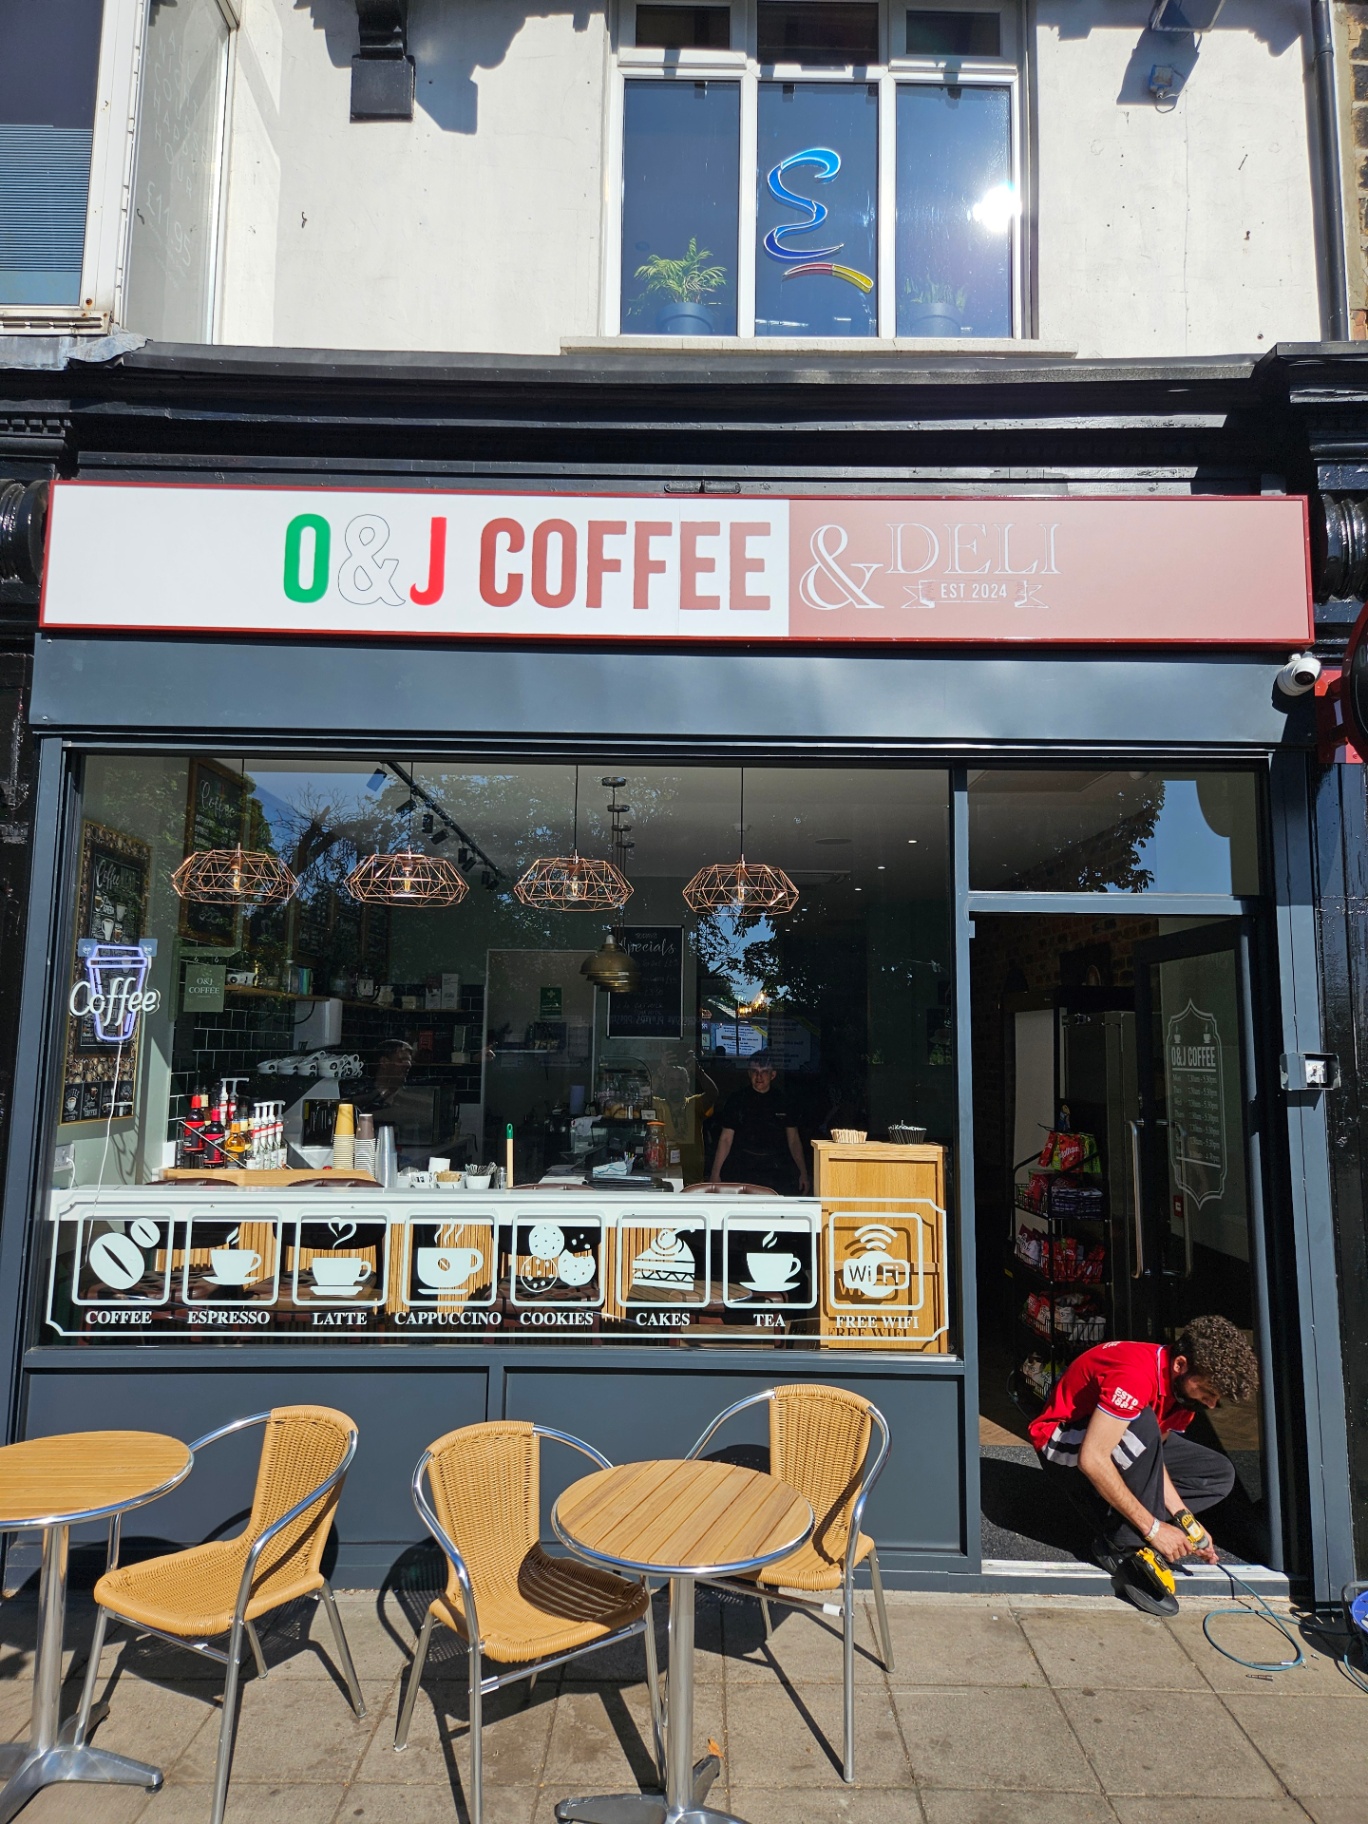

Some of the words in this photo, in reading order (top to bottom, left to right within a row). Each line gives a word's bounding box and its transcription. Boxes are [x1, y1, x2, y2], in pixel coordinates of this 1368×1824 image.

[479, 517, 771, 610] COFFEE
[799, 524, 884, 611] &
[885, 523, 1062, 574] DELI
[941, 584, 966, 598] EST
[972, 583, 1008, 598] 2024
[618, 936, 676, 957] Specials
[196, 977, 213, 986] O&J
[69, 977, 157, 1026] Coffee
[1171, 1046, 1187, 1067] O&J
[1187, 1046, 1216, 1067] COFFEE
[85, 1310, 152, 1324] COFFEE
[187, 1310, 270, 1324] ESPRESSO
[312, 1312, 368, 1326] LATTE
[394, 1311, 502, 1326] CAPPUCCINO
[519, 1311, 594, 1326] COOKIES
[635, 1312, 691, 1326] CAKES
[753, 1313, 786, 1327] TEA
[835, 1315, 878, 1328] FREE
[882, 1316, 919, 1329] WIFI
